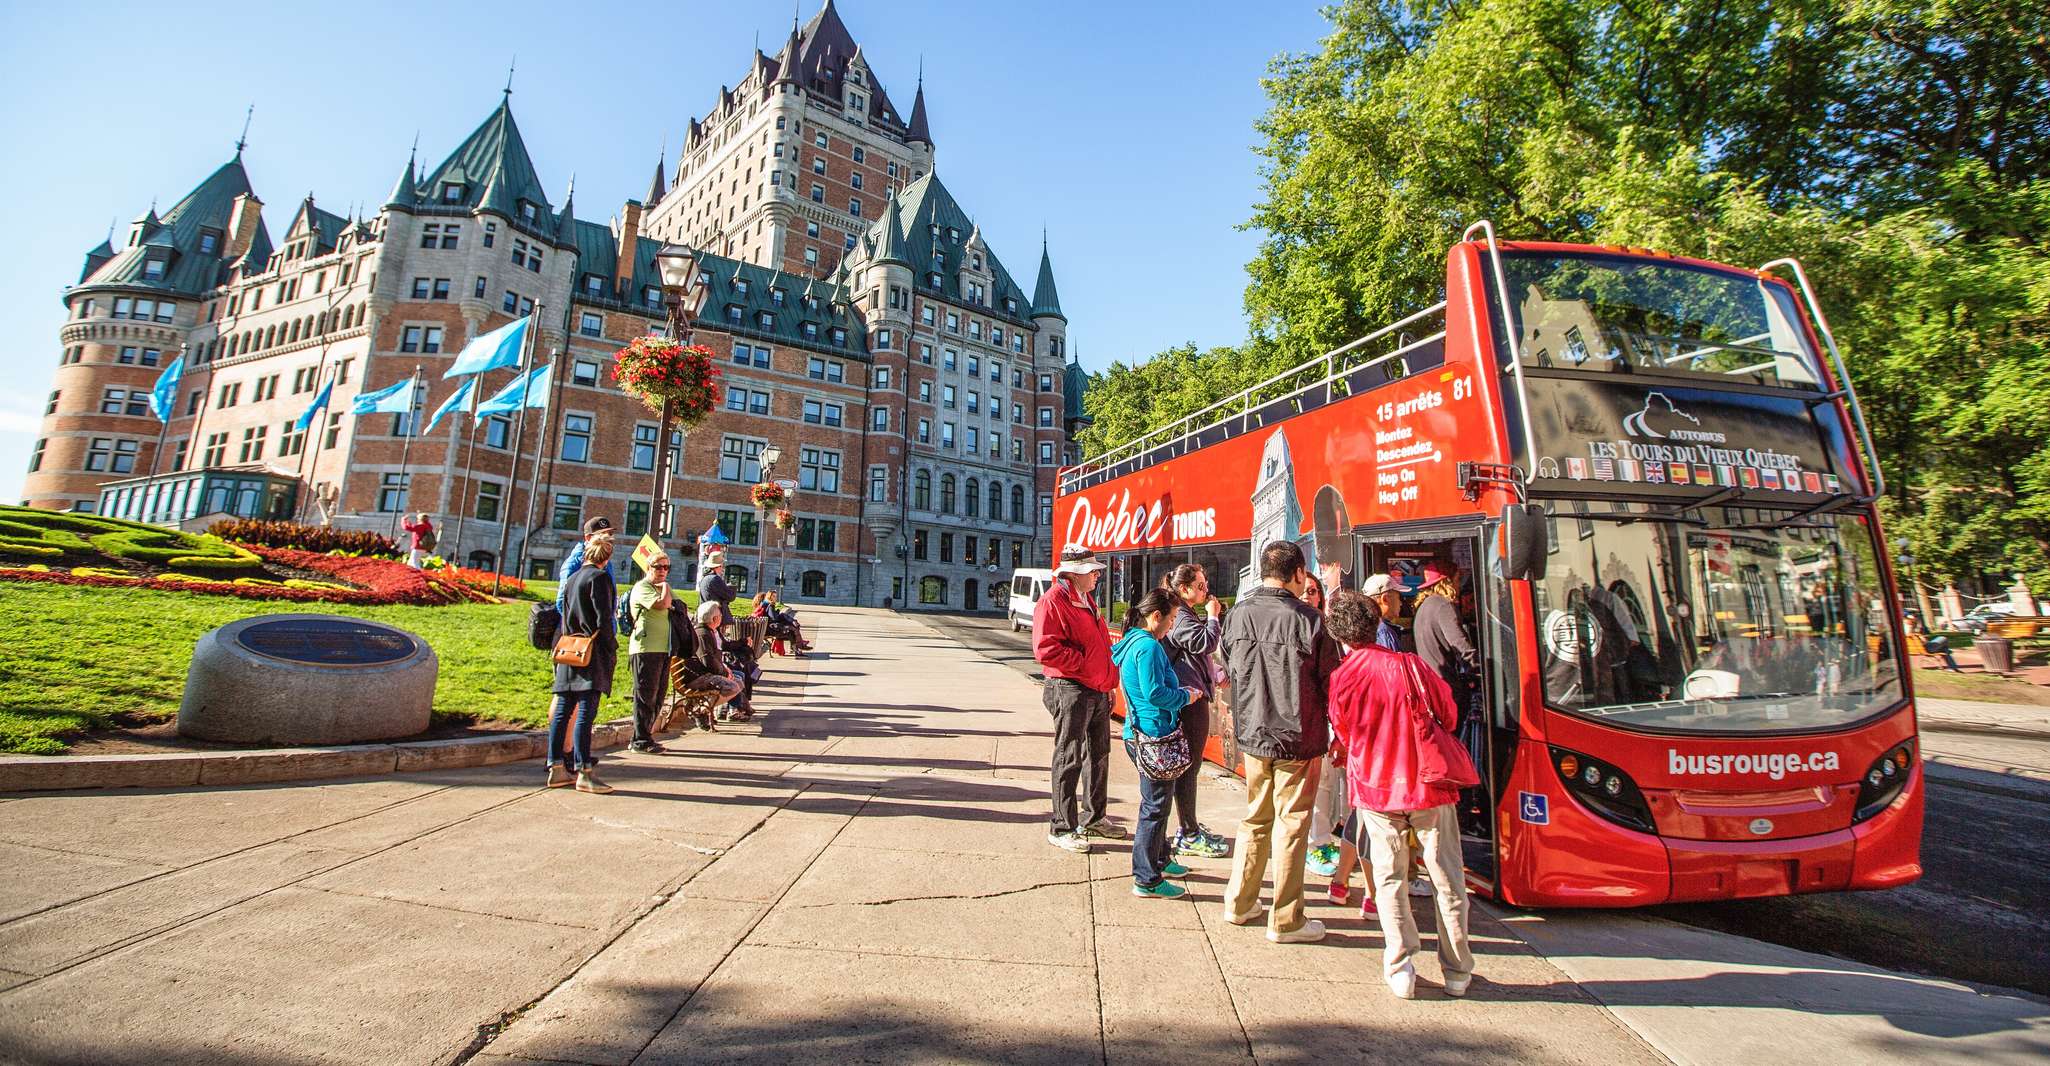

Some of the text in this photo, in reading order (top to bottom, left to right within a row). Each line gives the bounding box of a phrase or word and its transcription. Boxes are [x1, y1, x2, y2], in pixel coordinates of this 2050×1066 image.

[1453, 375, 1472, 400] 81
[1376, 390, 1443, 422] 15 arrêts
[1375, 427, 1413, 445] Montez
[1669, 429, 1726, 443] AUTOBUS
[1376, 441, 1433, 463] Descendez
[1588, 440, 1802, 472] LES TOURS DU VIEUX QUÉBEC
[1378, 468, 1416, 487] Hop On
[1378, 486, 1418, 506] Hop Off
[1066, 487, 1216, 548] Québec TOURS
[1668, 749, 1840, 781] busrouge.ca
